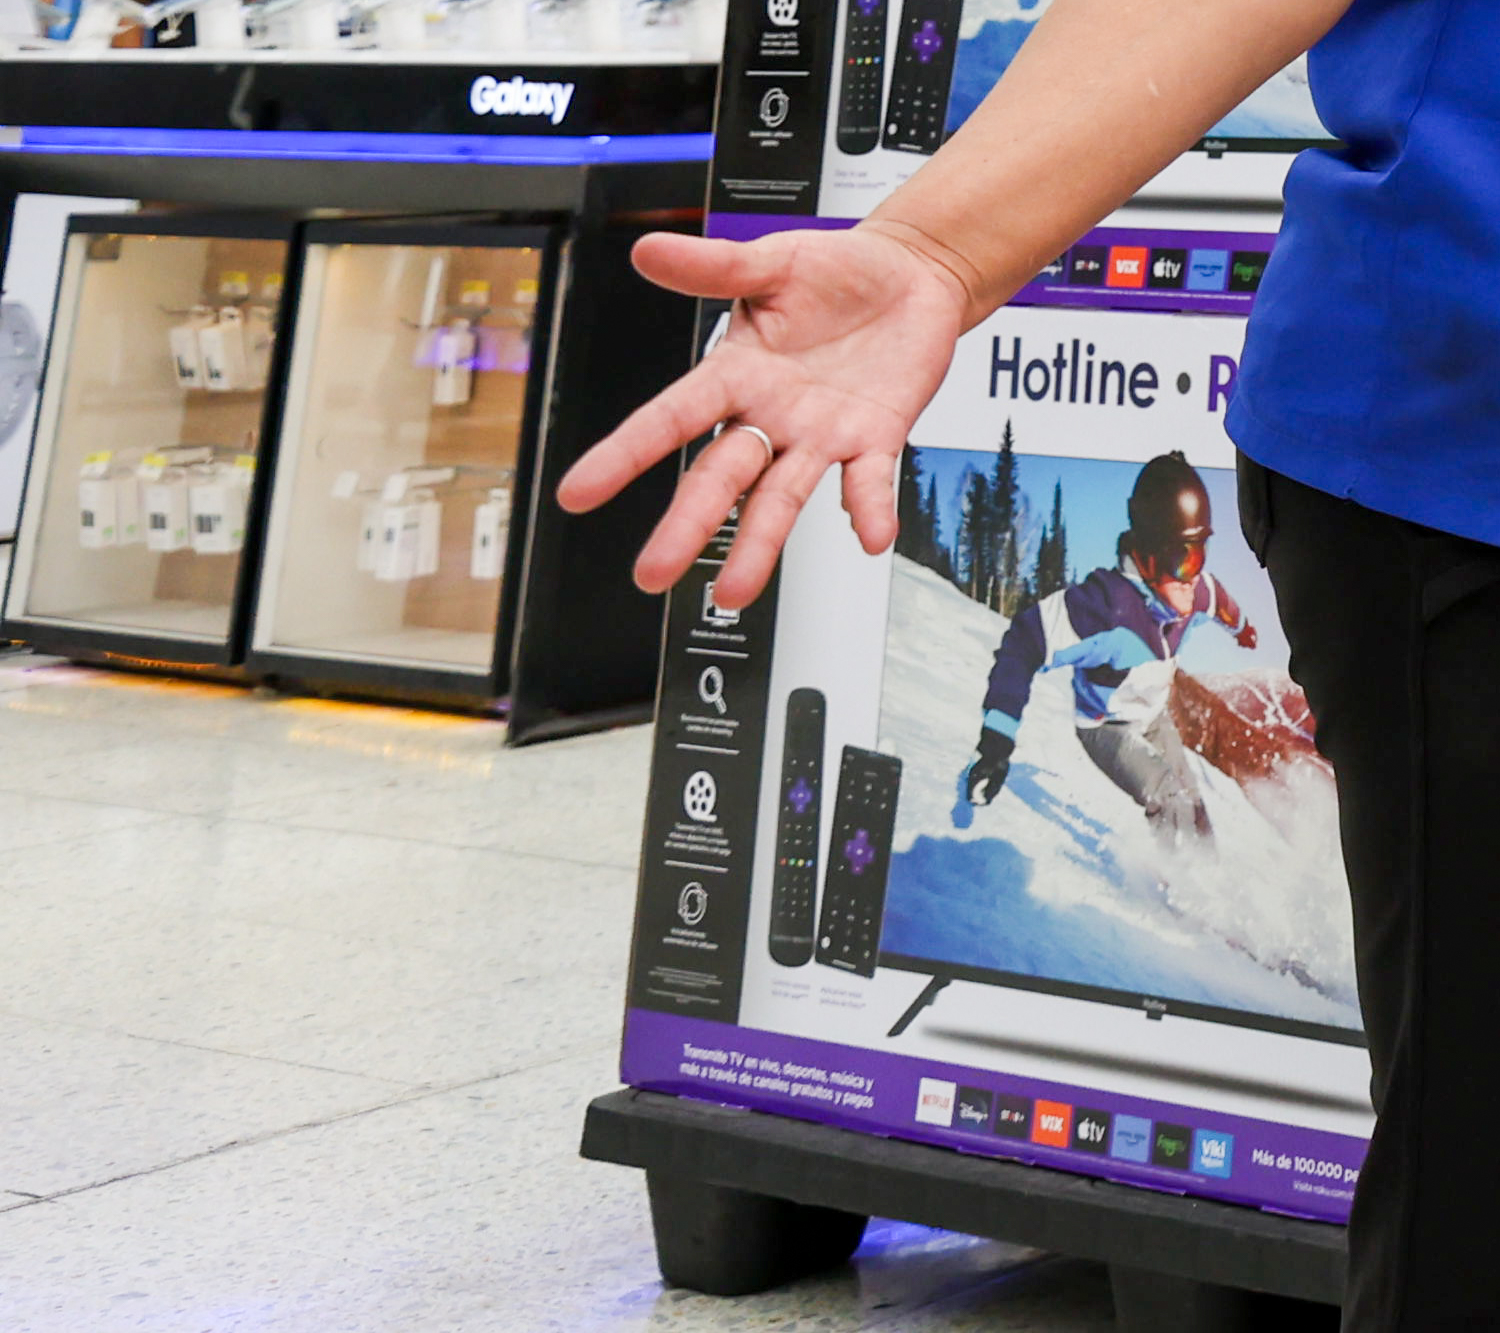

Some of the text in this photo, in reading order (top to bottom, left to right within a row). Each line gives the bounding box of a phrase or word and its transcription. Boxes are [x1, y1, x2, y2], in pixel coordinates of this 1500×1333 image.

[470, 73, 574, 126] Galaxy
[989, 336, 1159, 409] Hotline
[1253, 1148, 1342, 1181] Más de 100.000
